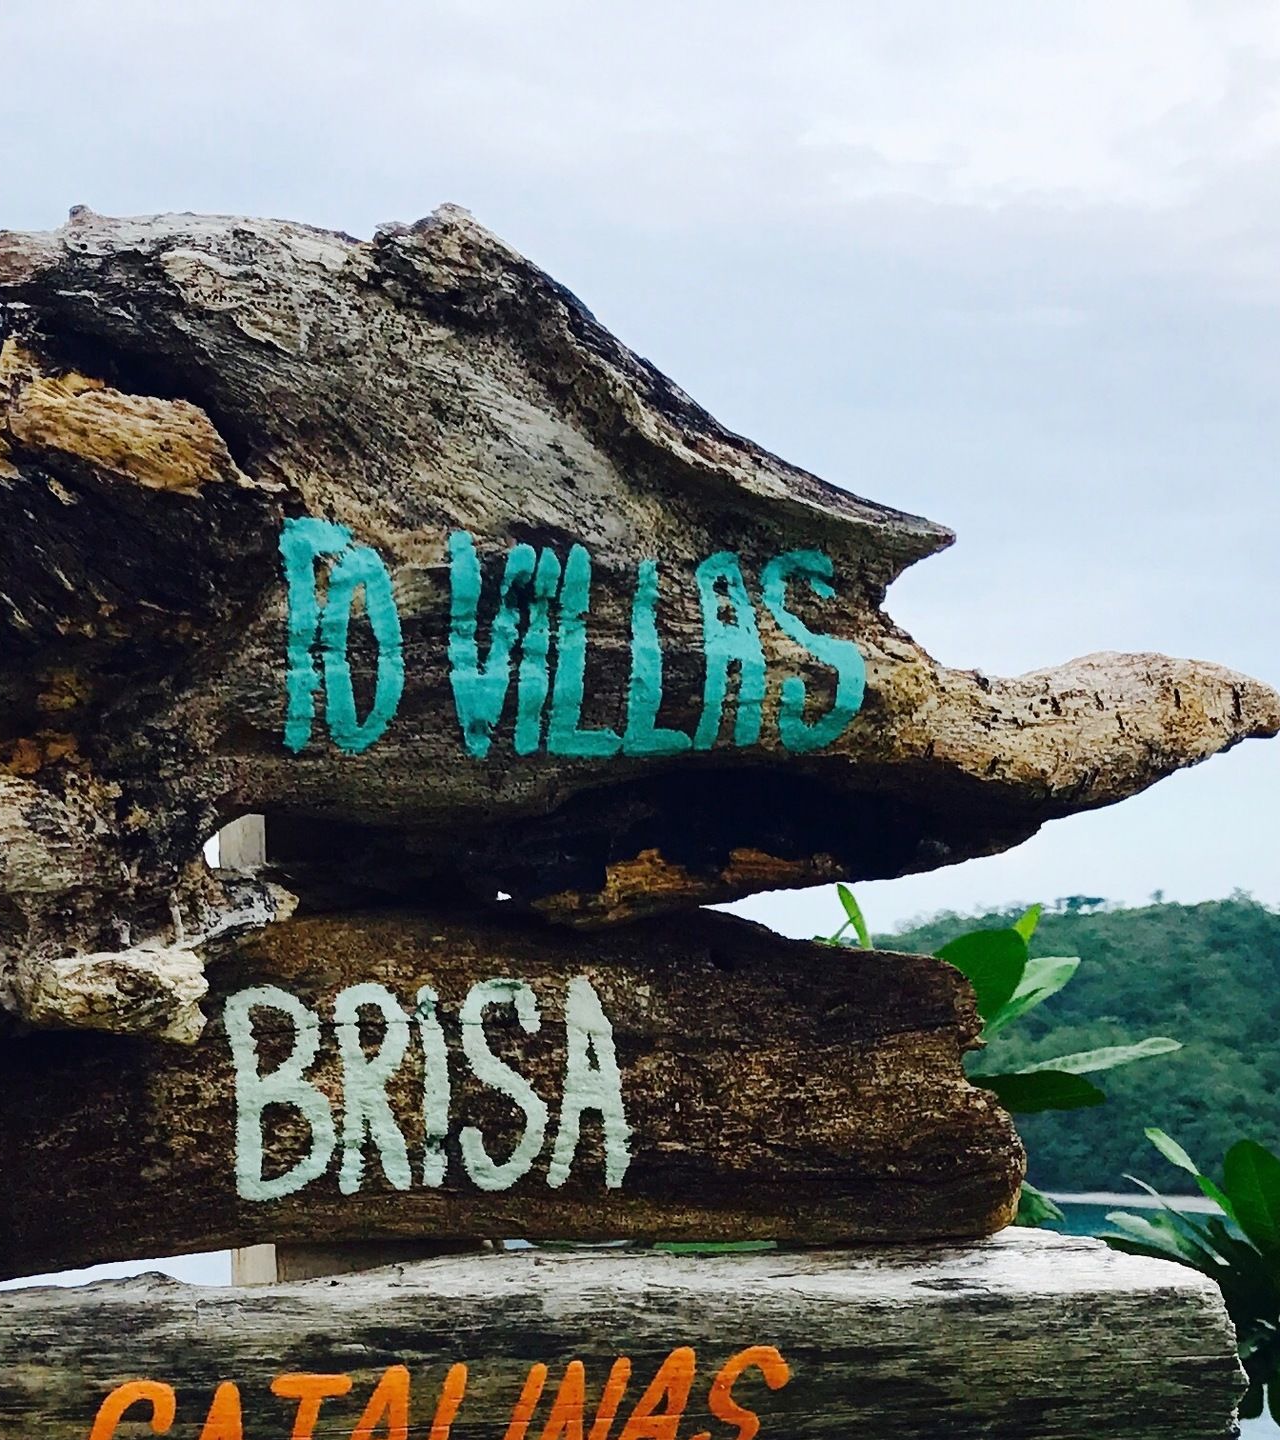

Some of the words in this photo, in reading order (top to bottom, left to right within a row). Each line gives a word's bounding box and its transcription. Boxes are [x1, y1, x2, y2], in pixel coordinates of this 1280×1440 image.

[278, 516, 406, 755] 10
[447, 530, 867, 758] VILLAS
[222, 974, 634, 1202] BRISA
